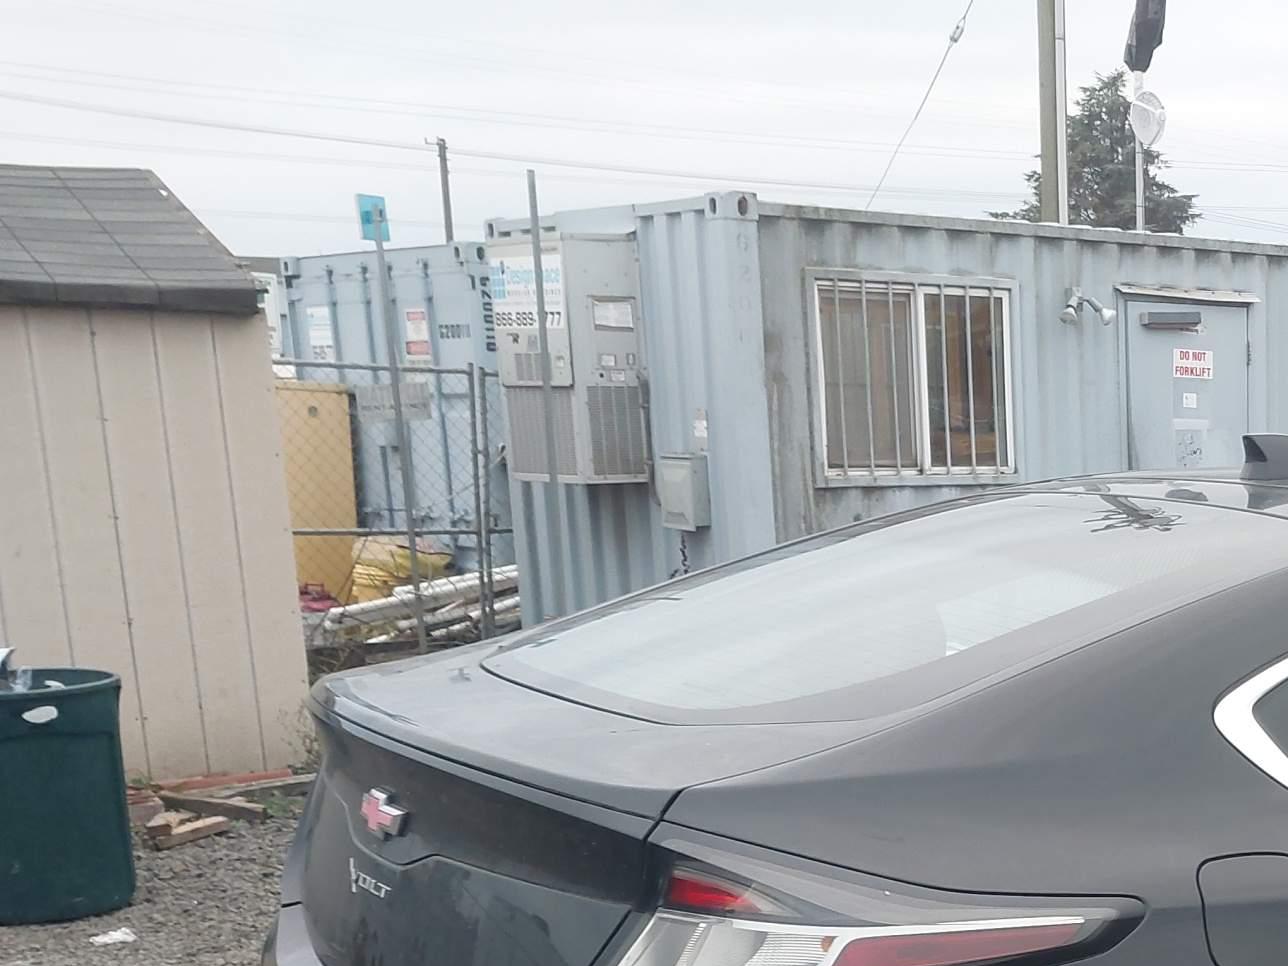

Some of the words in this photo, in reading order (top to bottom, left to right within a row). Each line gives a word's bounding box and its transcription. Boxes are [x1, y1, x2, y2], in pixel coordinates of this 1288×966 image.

[1179, 351, 1190, 360] DO
[1192, 352, 1206, 361] NOT
[1175, 366, 1211, 377] FORKLIFT
[349, 857, 392, 898] VOLT
